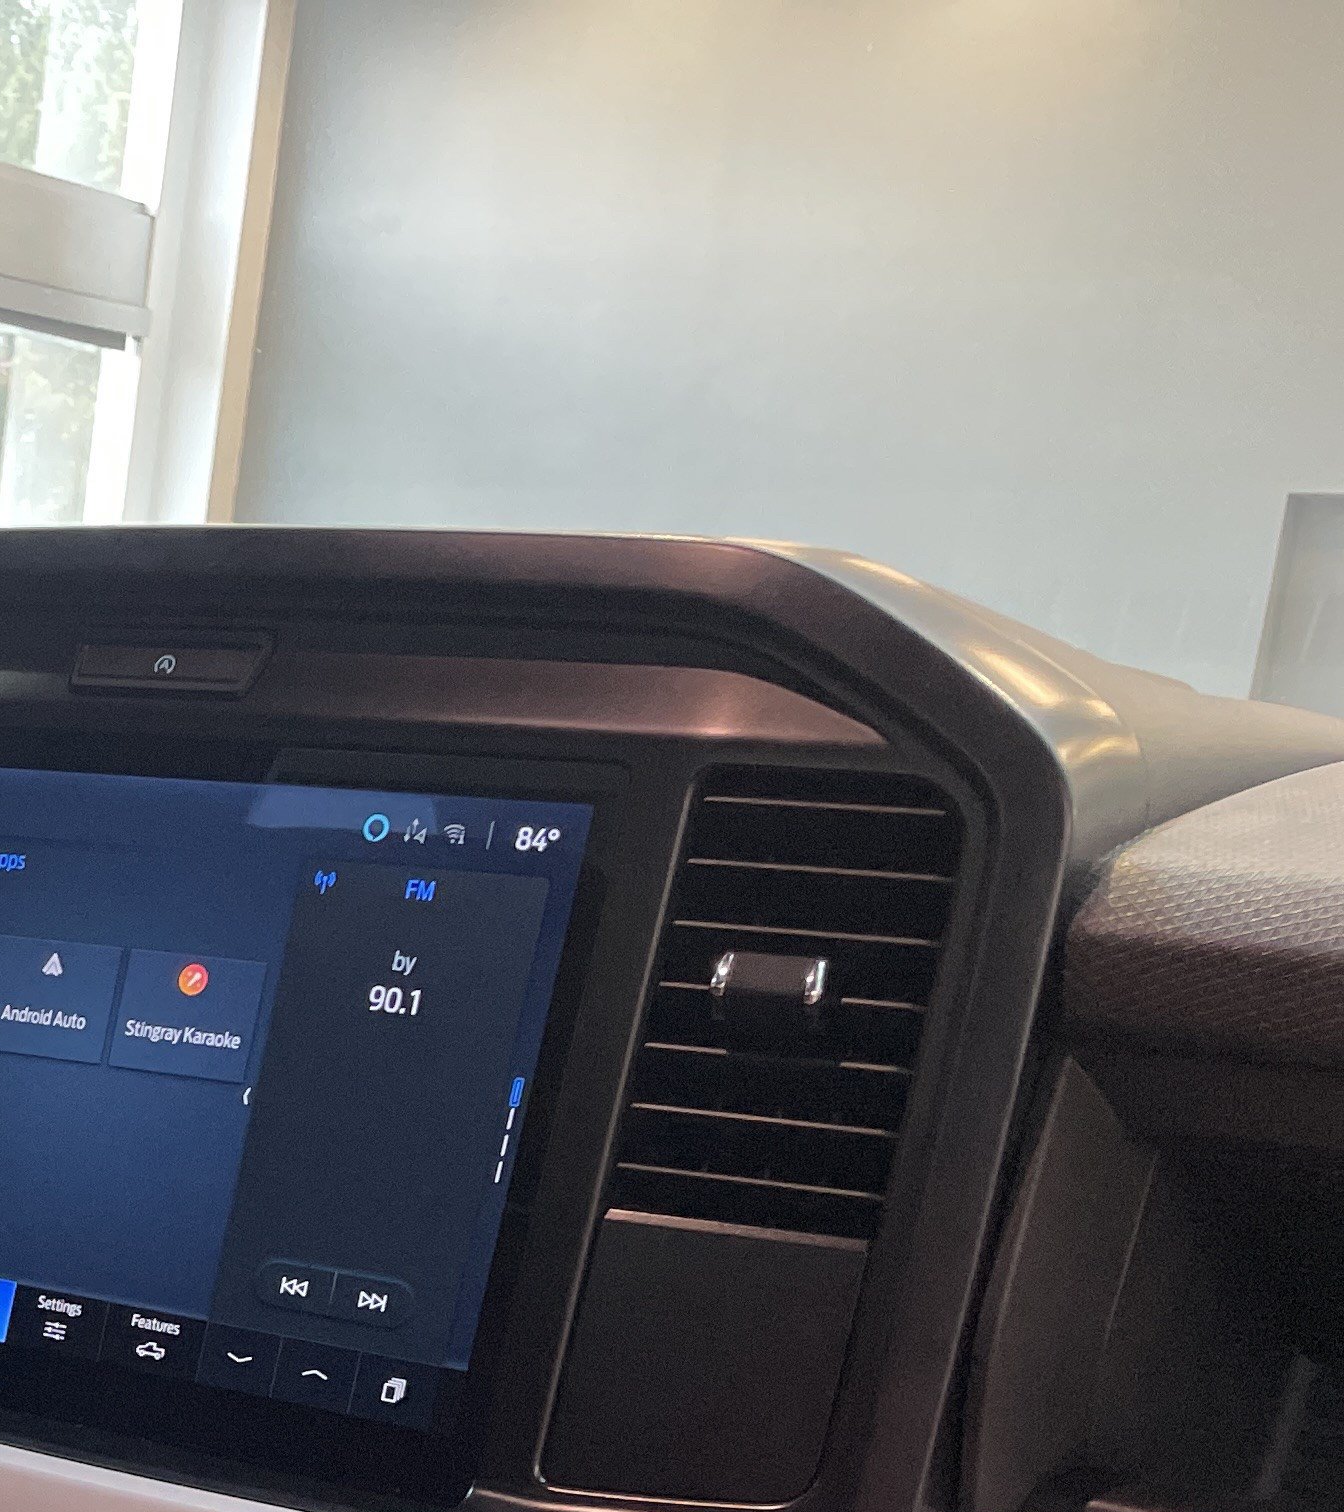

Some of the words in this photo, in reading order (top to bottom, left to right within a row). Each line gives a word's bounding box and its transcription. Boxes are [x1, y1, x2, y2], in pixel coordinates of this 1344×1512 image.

[404, 878, 438, 902] FM
[391, 950, 418, 977] by
[368, 984, 423, 1016] 90.1
[0, 1004, 52, 1028] Android
[52, 1009, 87, 1030] Auto
[124, 1018, 182, 1045] Stingray
[182, 1026, 242, 1050] Karaoke
[37, 1294, 82, 1318] Settings
[130, 1313, 181, 1336] Features
